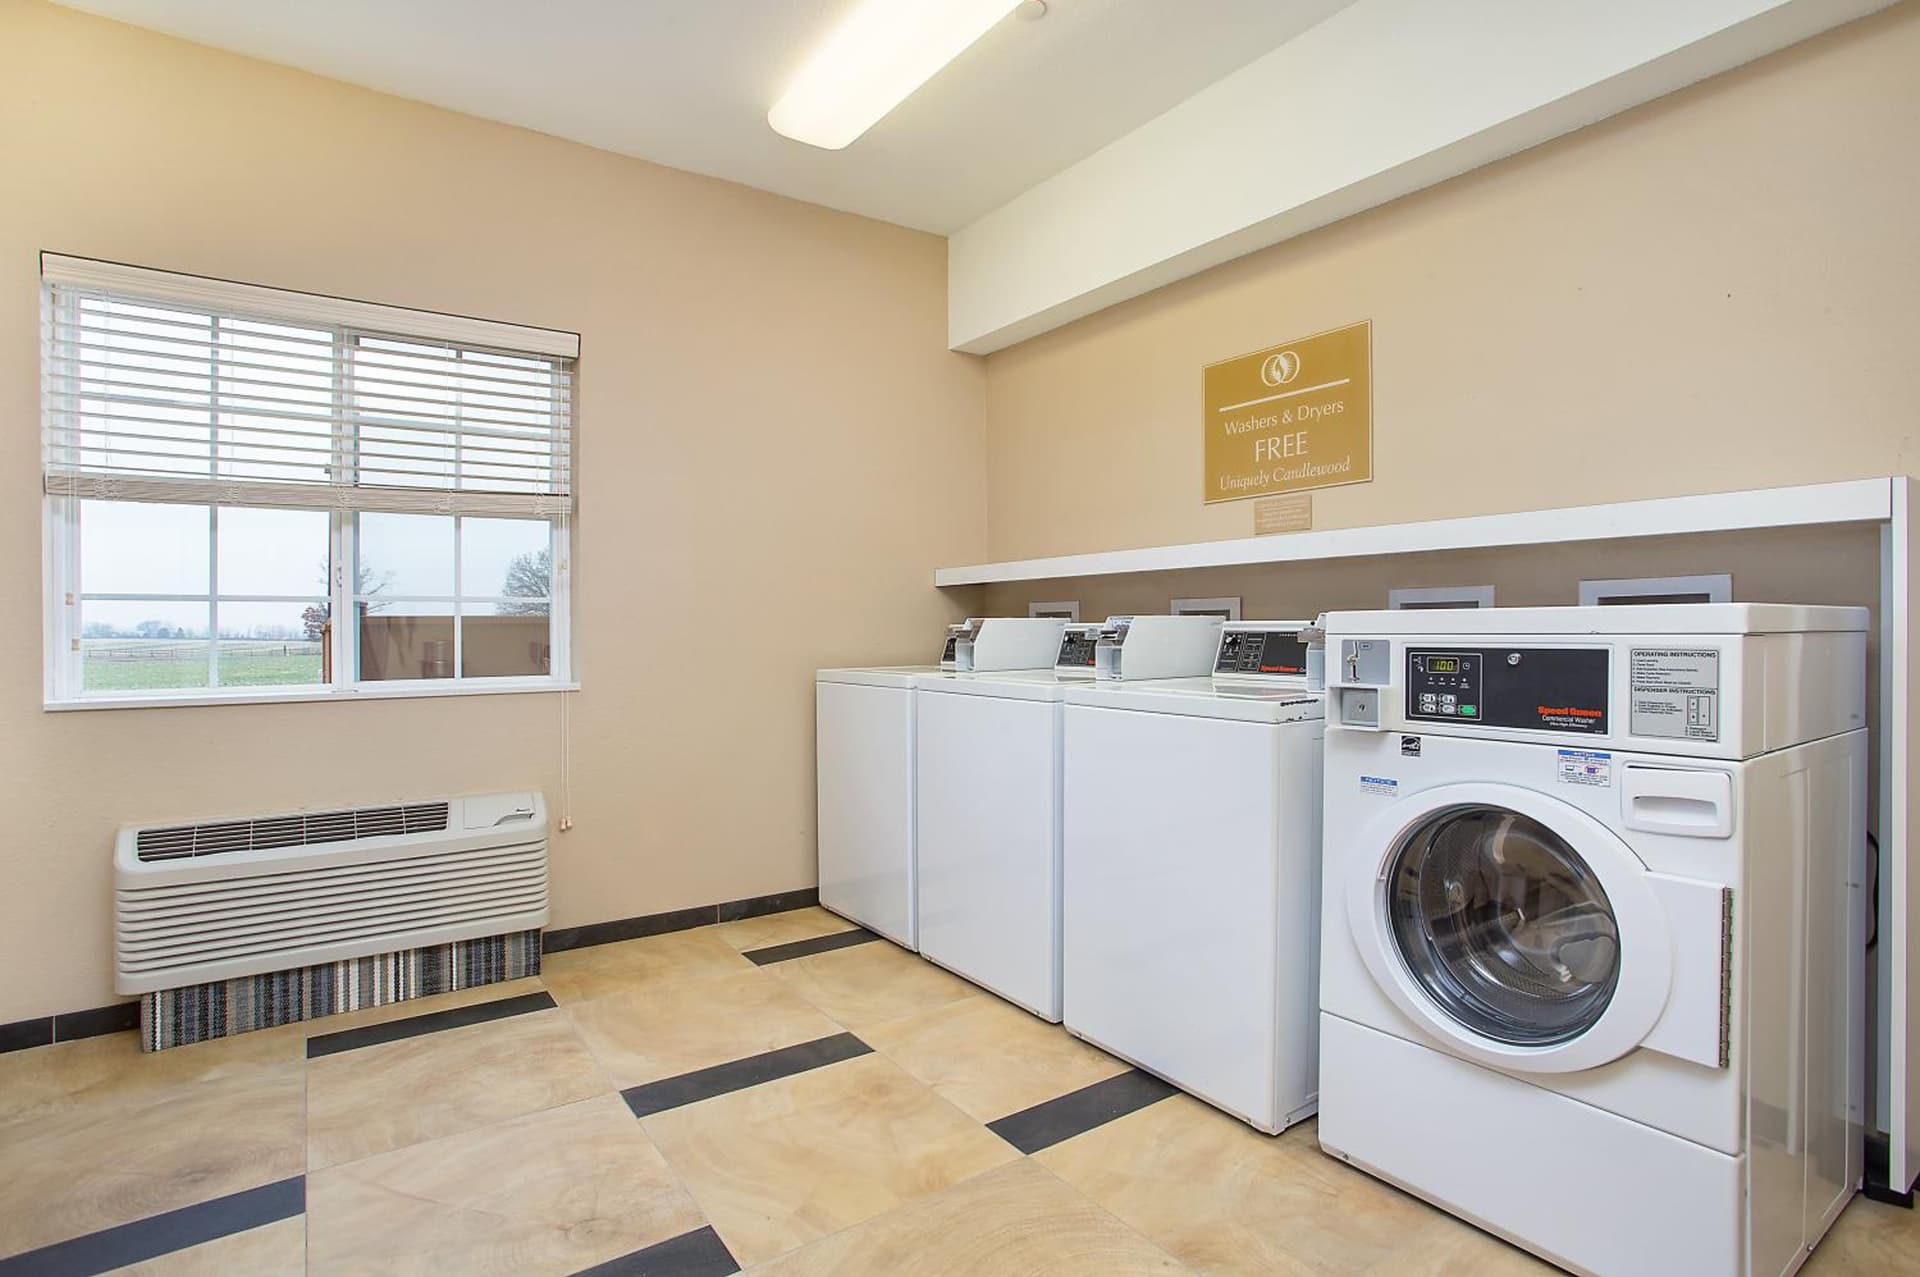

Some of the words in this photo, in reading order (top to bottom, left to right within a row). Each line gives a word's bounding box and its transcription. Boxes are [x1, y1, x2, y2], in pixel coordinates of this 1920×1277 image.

[1224, 411, 1278, 435] Washers
[1281, 409, 1293, 424] &
[1297, 399, 1345, 424] Dryers
[1254, 431, 1308, 462] FREE
[1220, 469, 1269, 491] Uniquely
[1272, 456, 1351, 483] Candlewood
[1538, 706, 1569, 715] Speed
[1569, 707, 1602, 717] Queen
